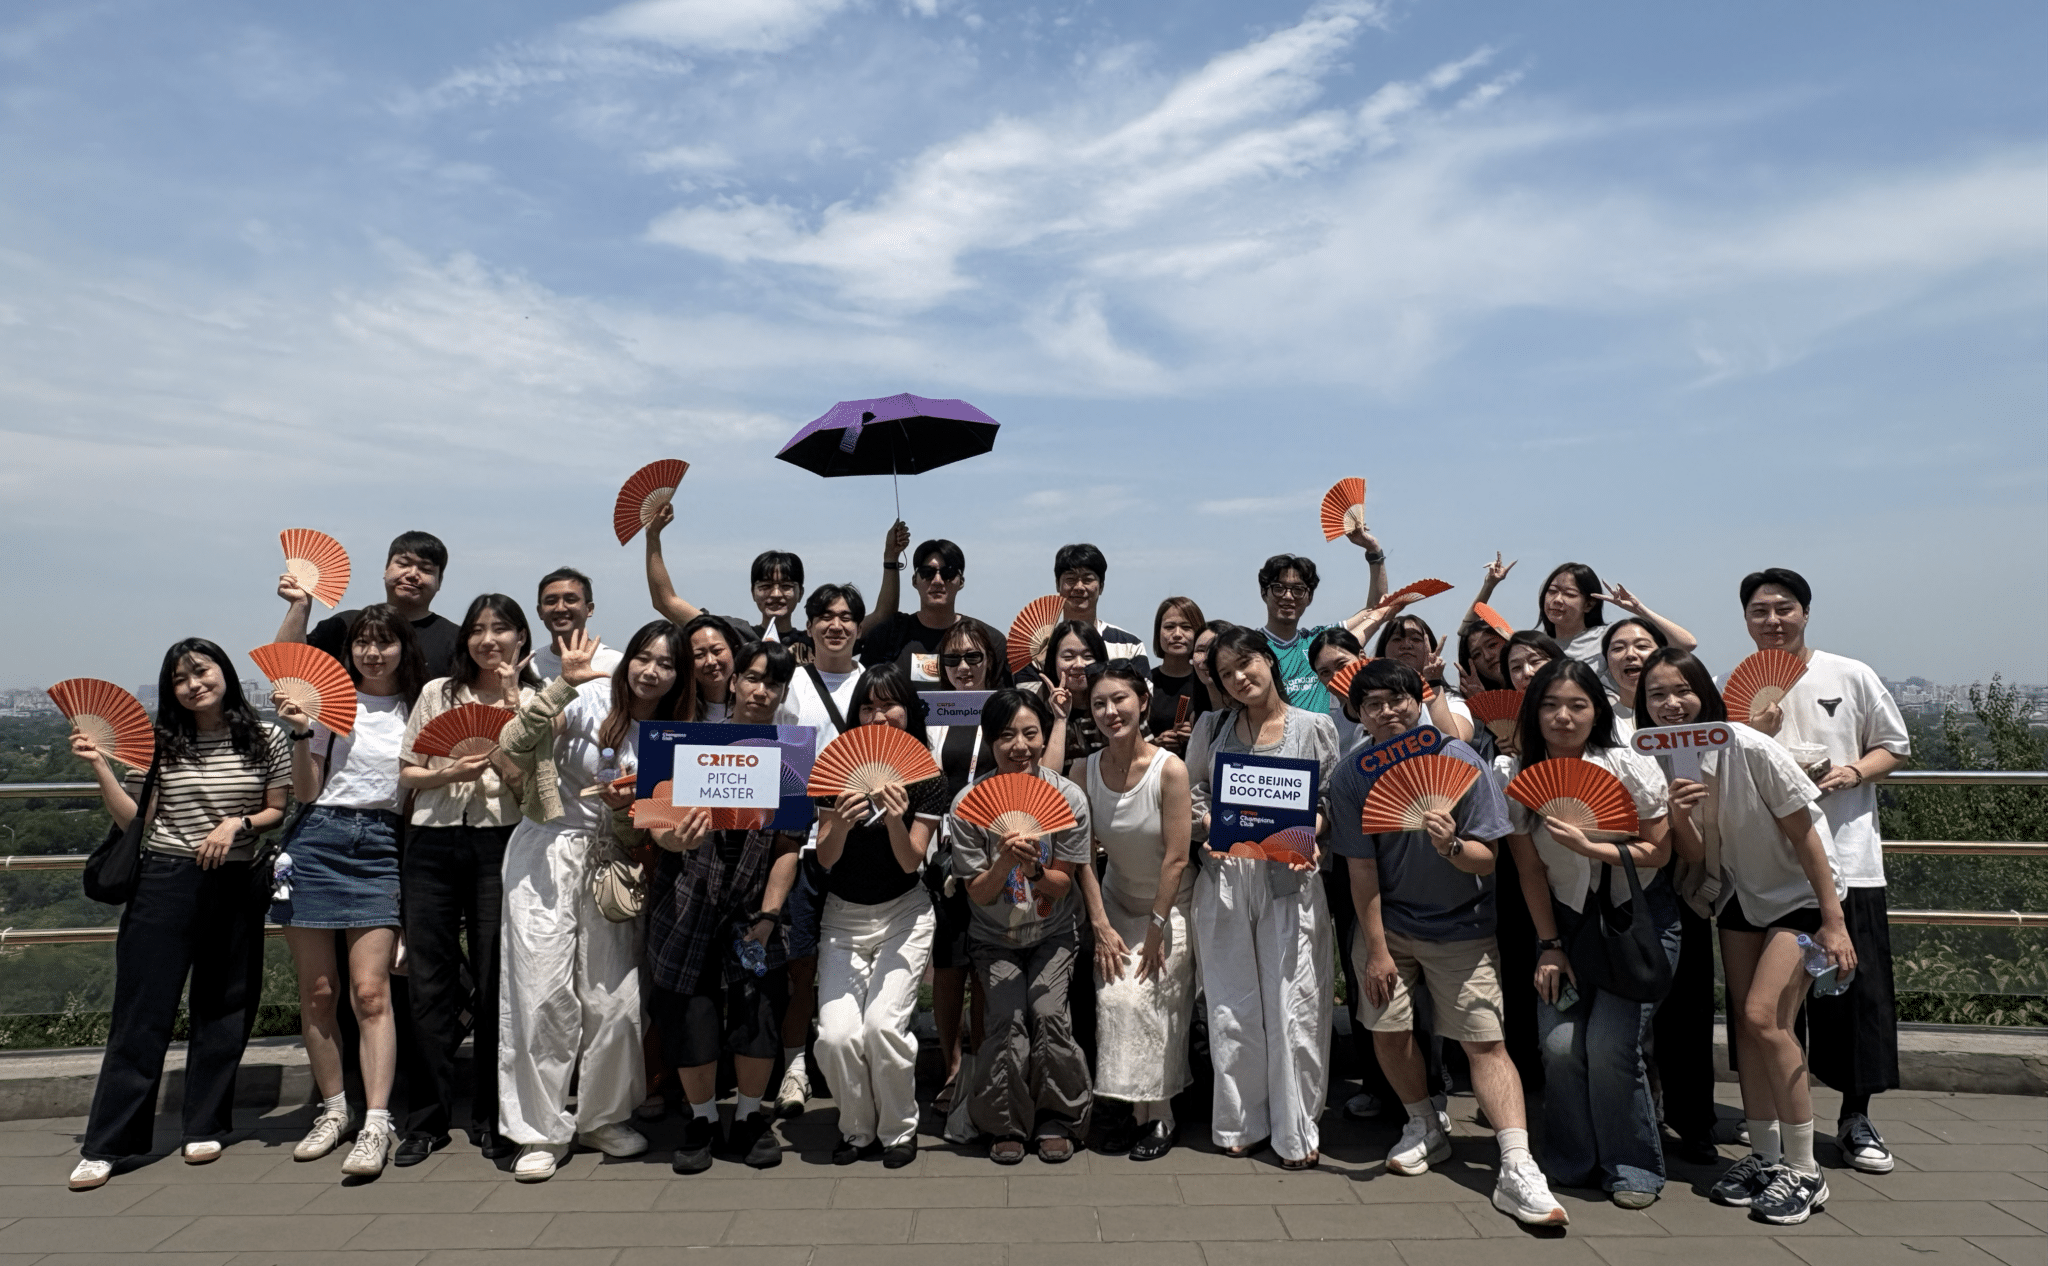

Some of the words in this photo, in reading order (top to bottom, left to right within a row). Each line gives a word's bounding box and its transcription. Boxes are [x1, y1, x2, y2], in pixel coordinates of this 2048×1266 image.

[1636, 728, 1729, 751] CRITEO
[1360, 729, 1436, 772] CRITEO
[697, 753, 759, 767] CRITEO
[707, 772, 747, 785] PITCH
[1229, 773, 1255, 784] CCC
[1258, 775, 1302, 788] BEIJING
[699, 787, 754, 800] MASTER
[1229, 785, 1301, 801] BOOTCAMP
